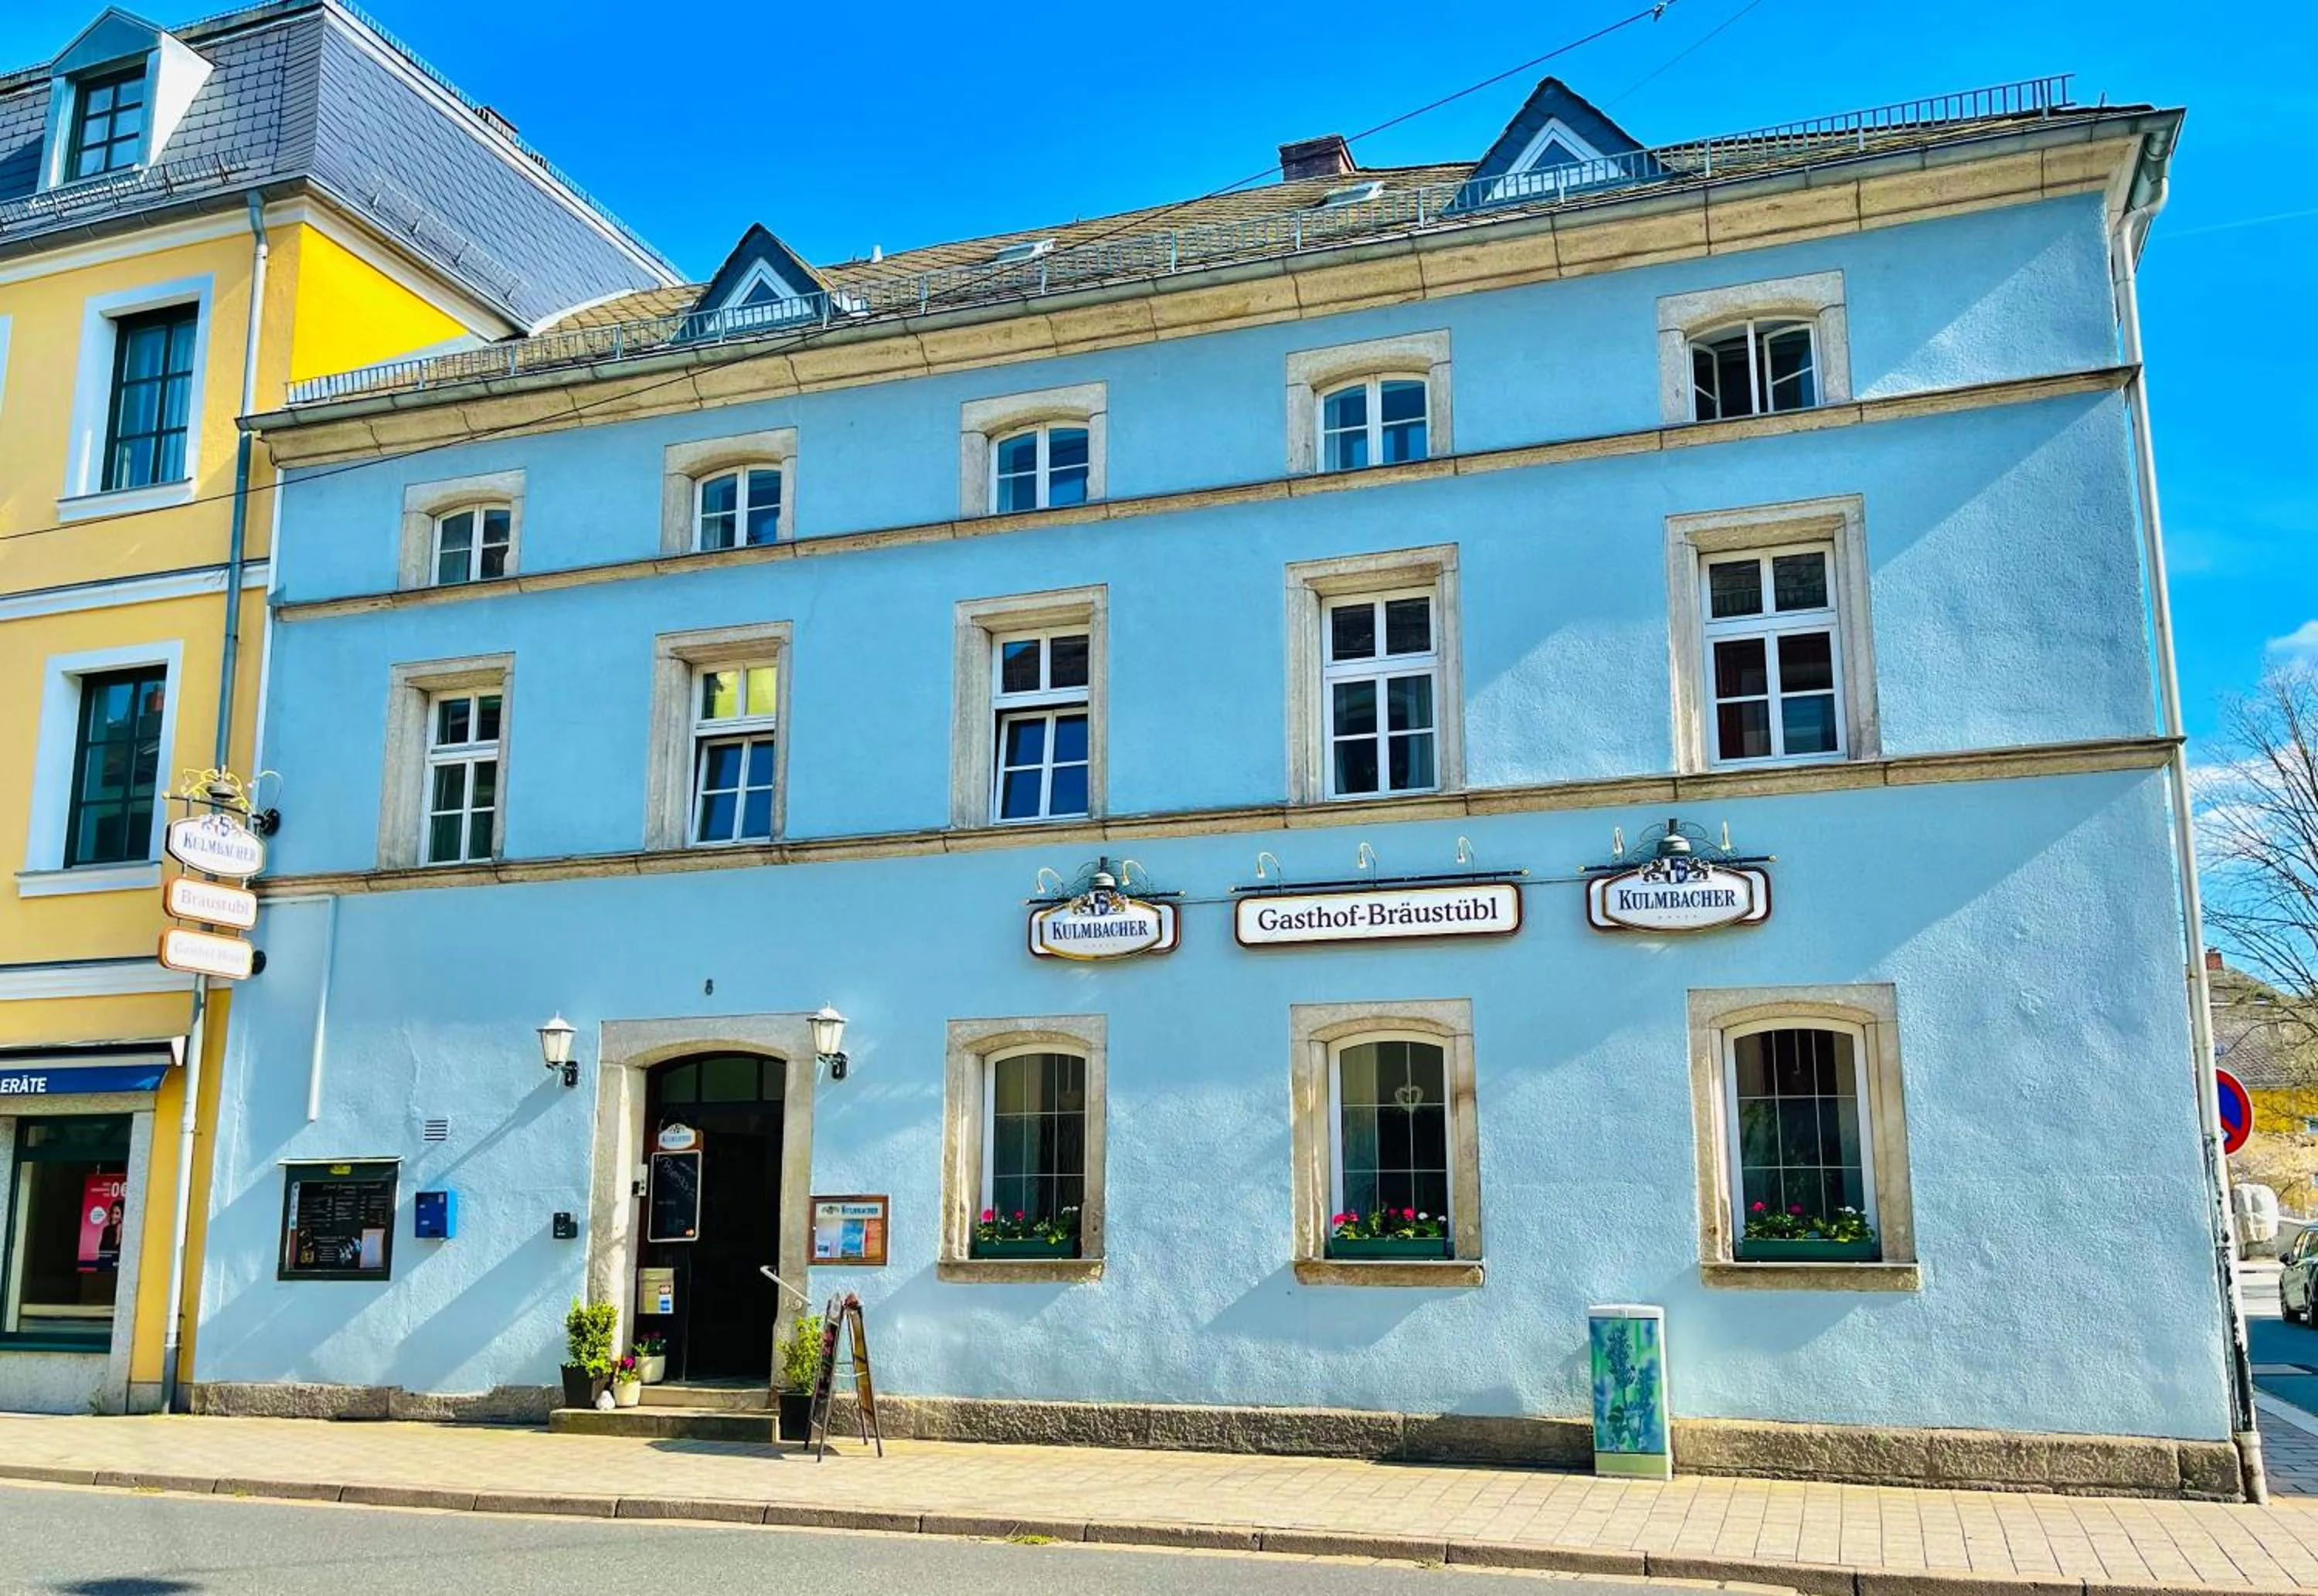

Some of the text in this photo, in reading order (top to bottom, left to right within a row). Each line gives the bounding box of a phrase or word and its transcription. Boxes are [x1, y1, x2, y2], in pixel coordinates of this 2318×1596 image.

[183, 832, 256, 862] KULMBACHER
[1619, 889, 1737, 911] KULMBACHER
[1258, 897, 1498, 932] Gasthof-Bräustübl
[1052, 919, 1149, 940] KULMBACHER
